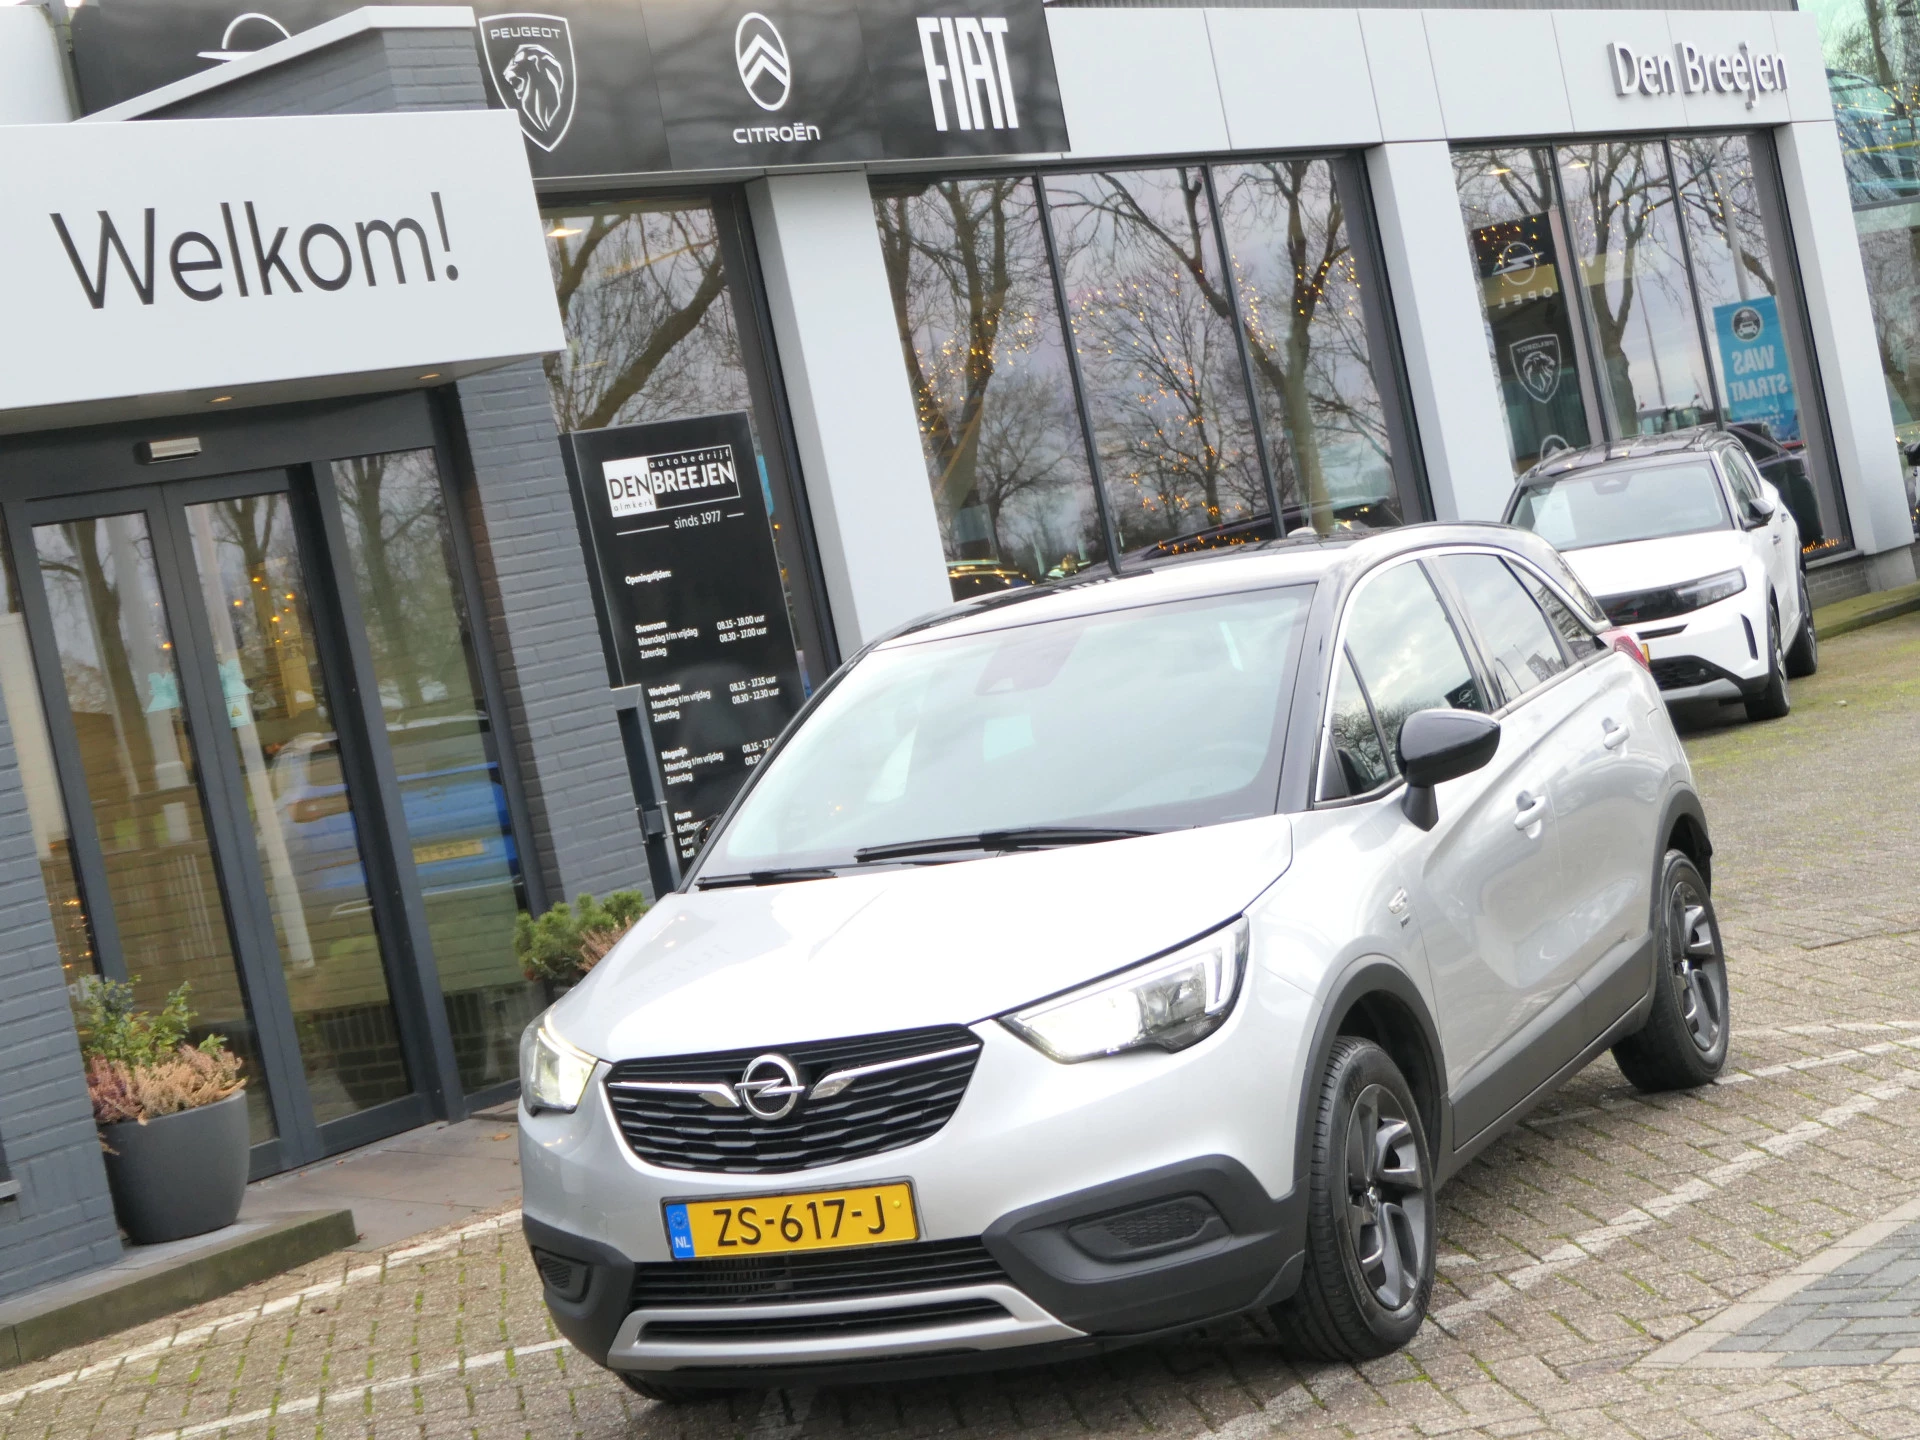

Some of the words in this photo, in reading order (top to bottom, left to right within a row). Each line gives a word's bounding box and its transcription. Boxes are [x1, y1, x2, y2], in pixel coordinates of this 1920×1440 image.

[490, 26, 560, 40] PEUGEOT
[916, 17, 1020, 131] FIAT
[1606, 42, 1679, 96] Den
[1674, 40, 1789, 110] Breejen
[50, 191, 459, 310] Welkom!
[650, 449, 731, 468] autobedrijf
[608, 473, 652, 500] DEN
[651, 461, 736, 494] BREEJEN
[674, 515, 699, 529] sinds
[701, 510, 721, 526] 1977
[635, 621, 667, 634] Showroom
[717, 619, 734, 630] 08.15
[737, 615, 753, 627] 18.00
[754, 615, 765, 623] uur
[638, 634, 666, 646] Maandag
[666, 632, 677, 641] t/m
[677, 628, 698, 639] vrijdag
[719, 632, 736, 643] 08.30
[740, 628, 756, 639] 17.00
[757, 627, 767, 635] uur
[640, 648, 667, 659] Zaterdag
[729, 681, 746, 692] 08.15
[766, 676, 777, 684] uur
[651, 697, 679, 709] Maandag
[679, 694, 690, 703] t/m
[690, 690, 711, 701] vrijdag
[732, 693, 749, 704] 08.30
[753, 689, 769, 700] 12.30
[769, 688, 779, 696] uur
[653, 710, 680, 722] Zaterdag
[742, 741, 759, 753] 08.15
[664, 760, 692, 772] Maandag
[692, 757, 703, 765] t/m
[703, 752, 724, 763] vrijdag
[666, 772, 693, 785] Zaterdag
[713, 1195, 887, 1247] ZS-617-J
[675, 1236, 691, 1249] NL
